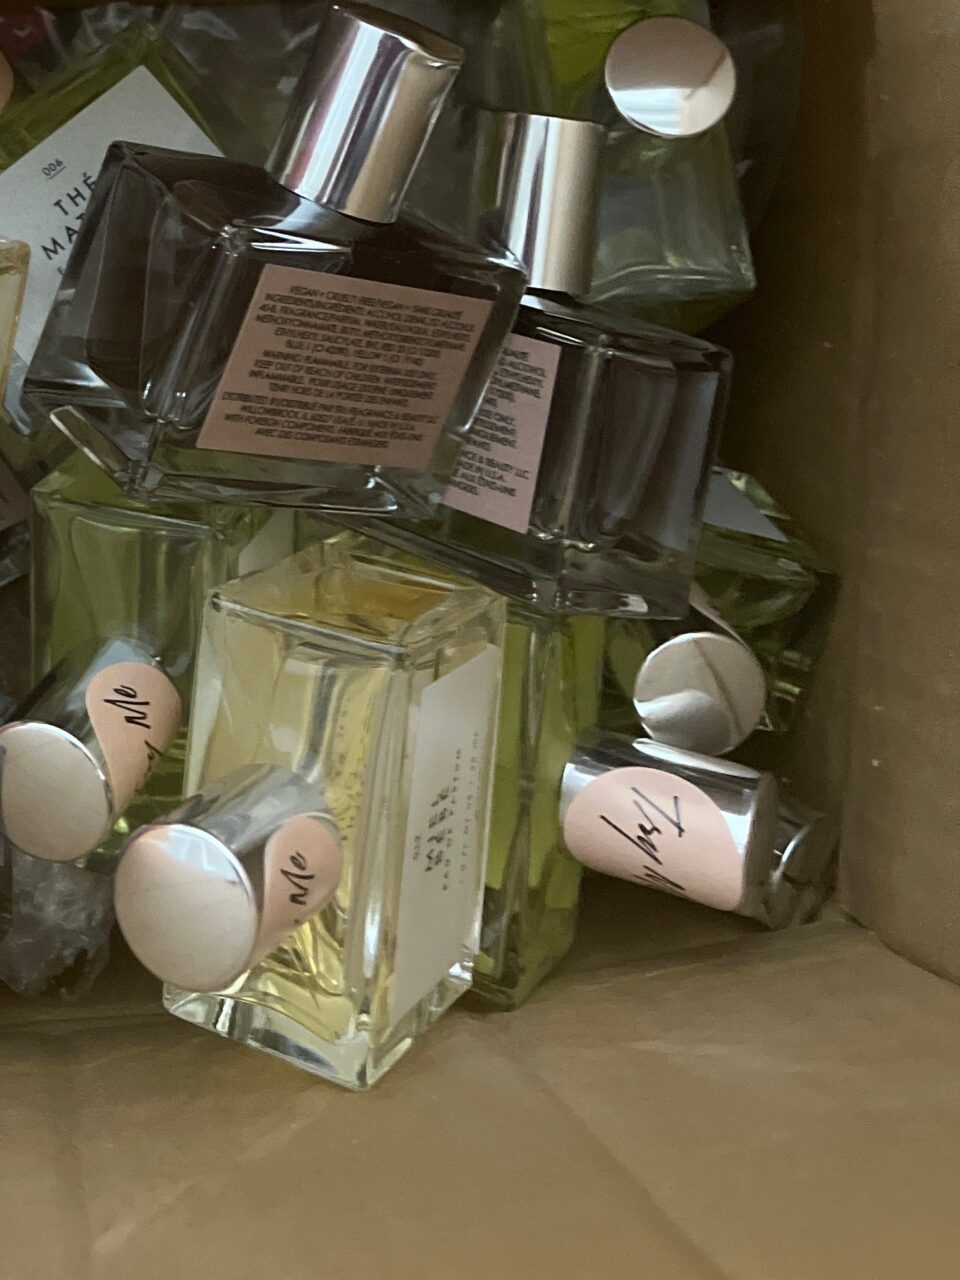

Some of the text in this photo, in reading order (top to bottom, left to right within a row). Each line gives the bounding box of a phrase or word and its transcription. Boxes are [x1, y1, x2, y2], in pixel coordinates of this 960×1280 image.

[42, 158, 64, 177] 006
[53, 172, 96, 216] THÉ
[102, 684, 152, 730] Me
[280, 850, 316, 906] Me
